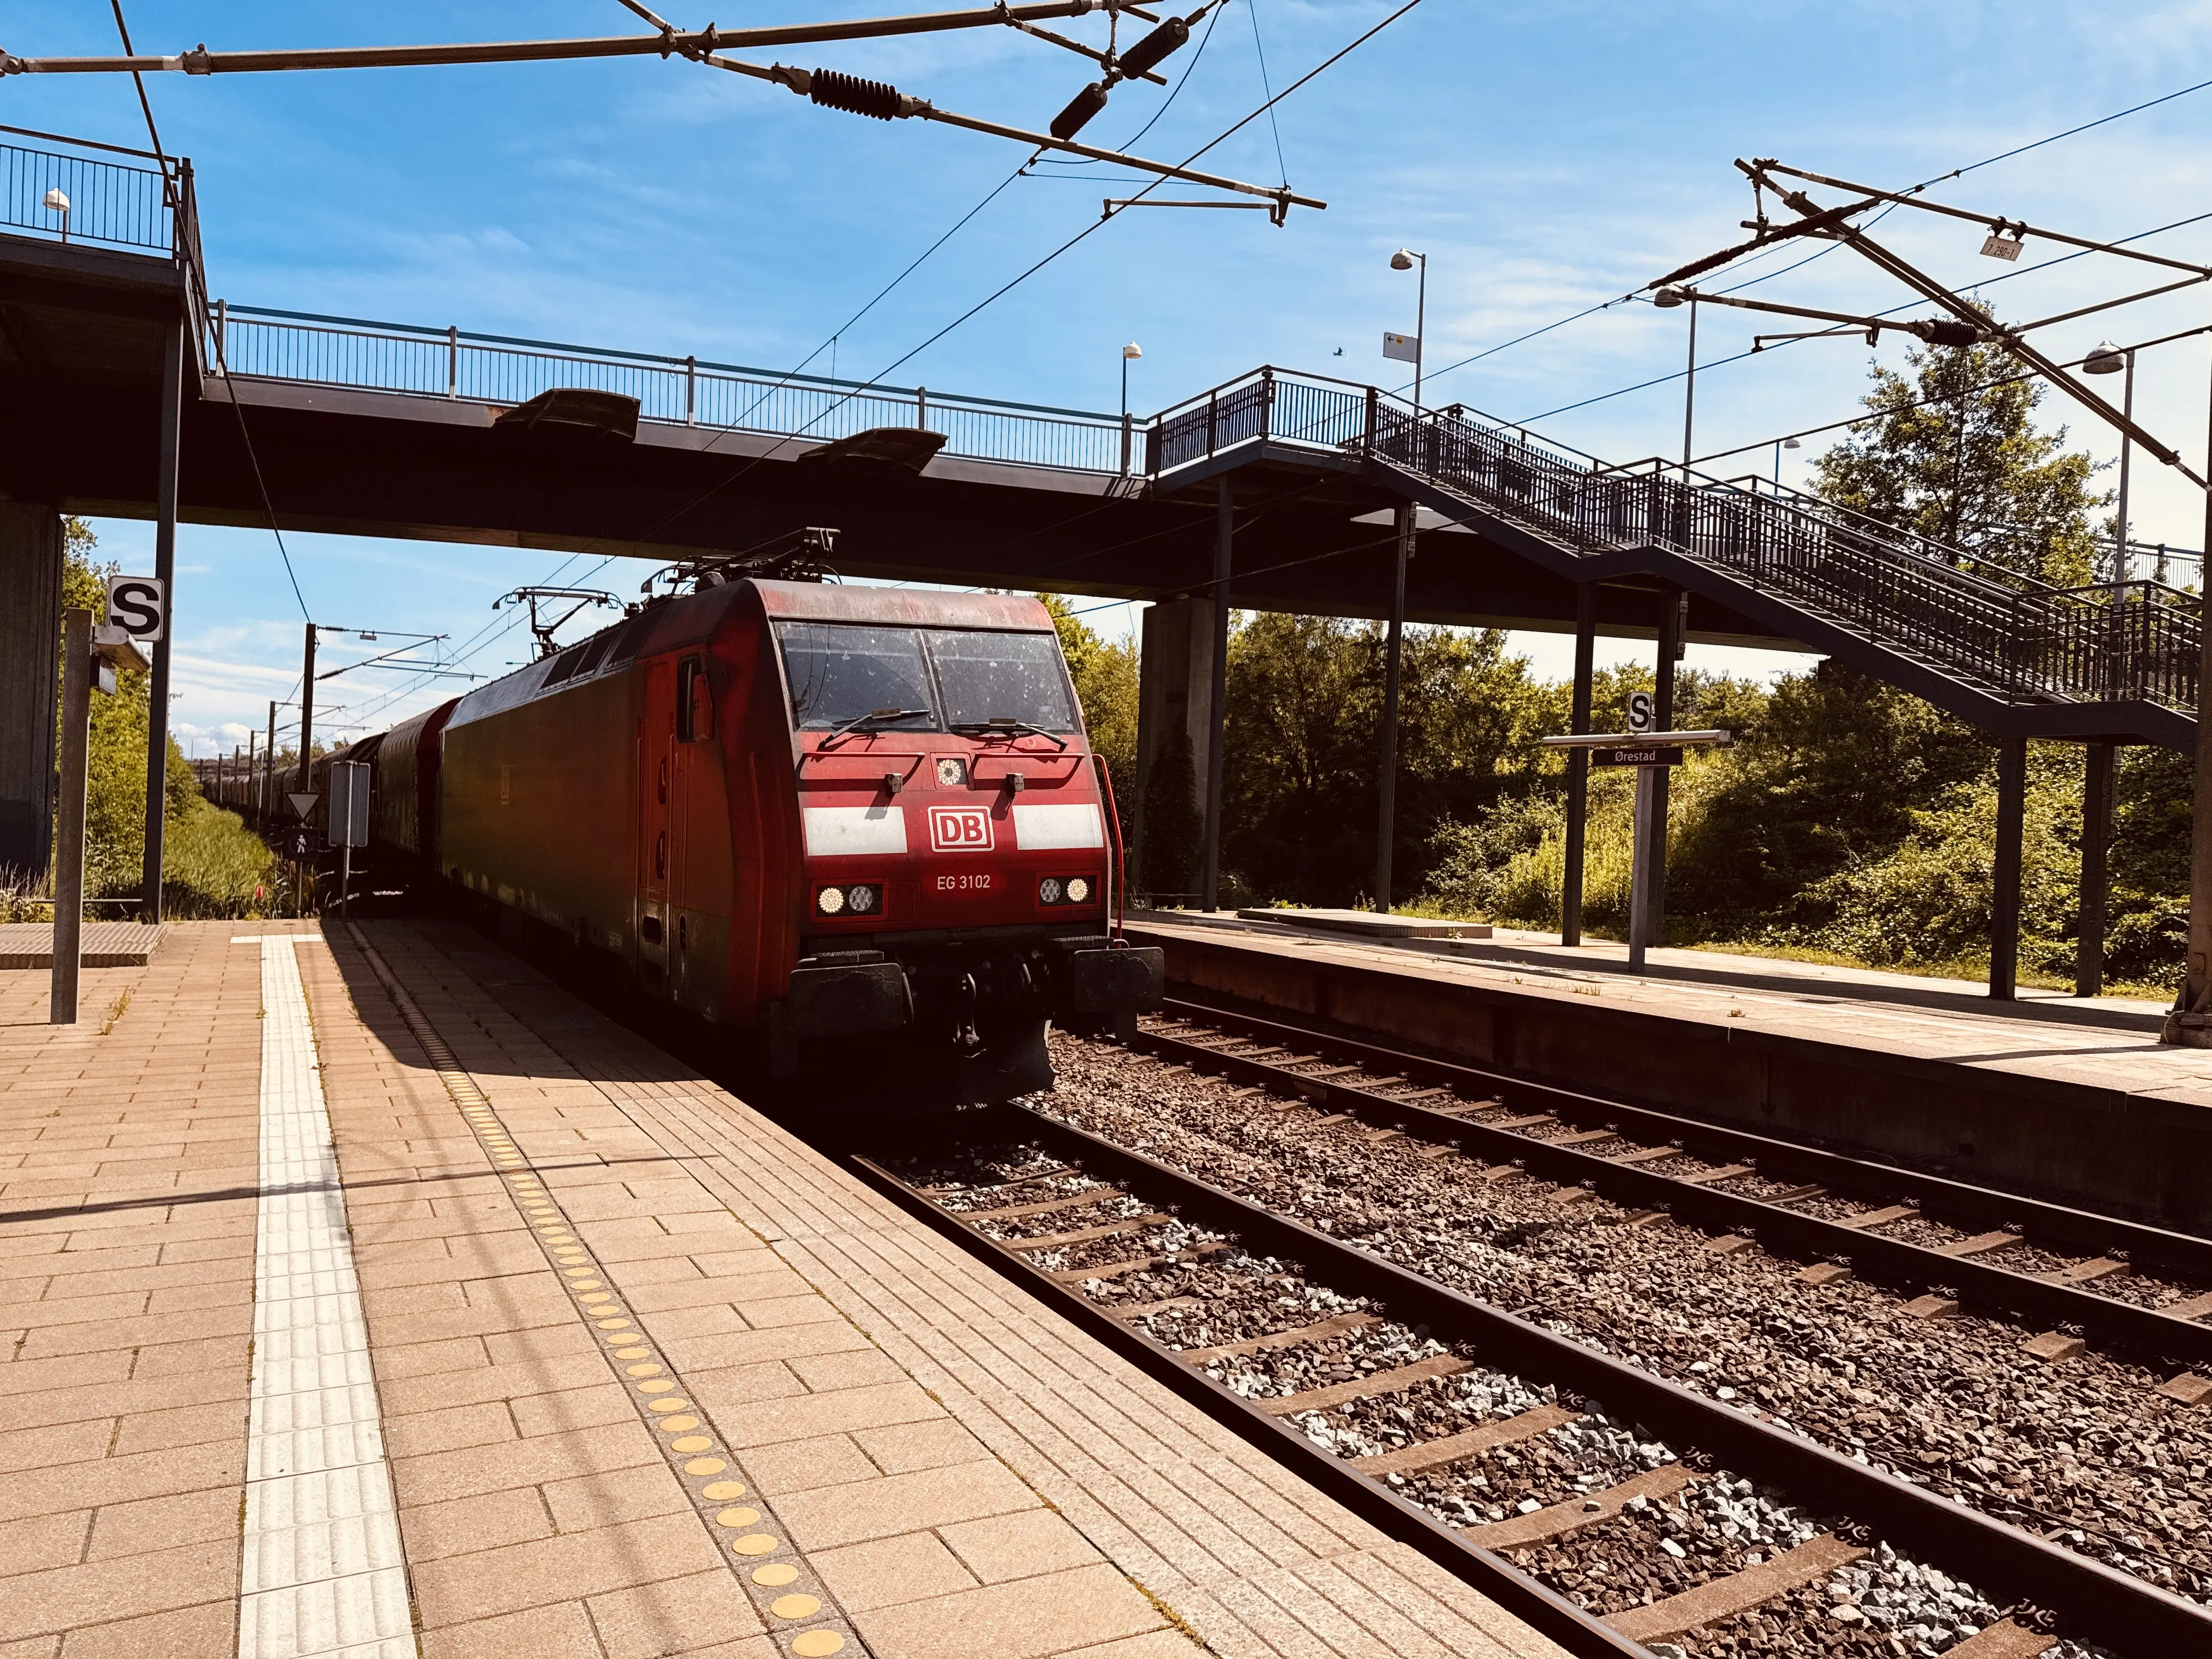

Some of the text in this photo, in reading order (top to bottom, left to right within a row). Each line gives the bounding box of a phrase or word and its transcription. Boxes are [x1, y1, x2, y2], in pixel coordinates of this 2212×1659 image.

[110, 583, 160, 635] S
[1629, 695, 1649, 728] S
[1615, 750, 1656, 761] Ørestad
[940, 815, 983, 842] DB
[937, 874, 991, 890] EG 3102
